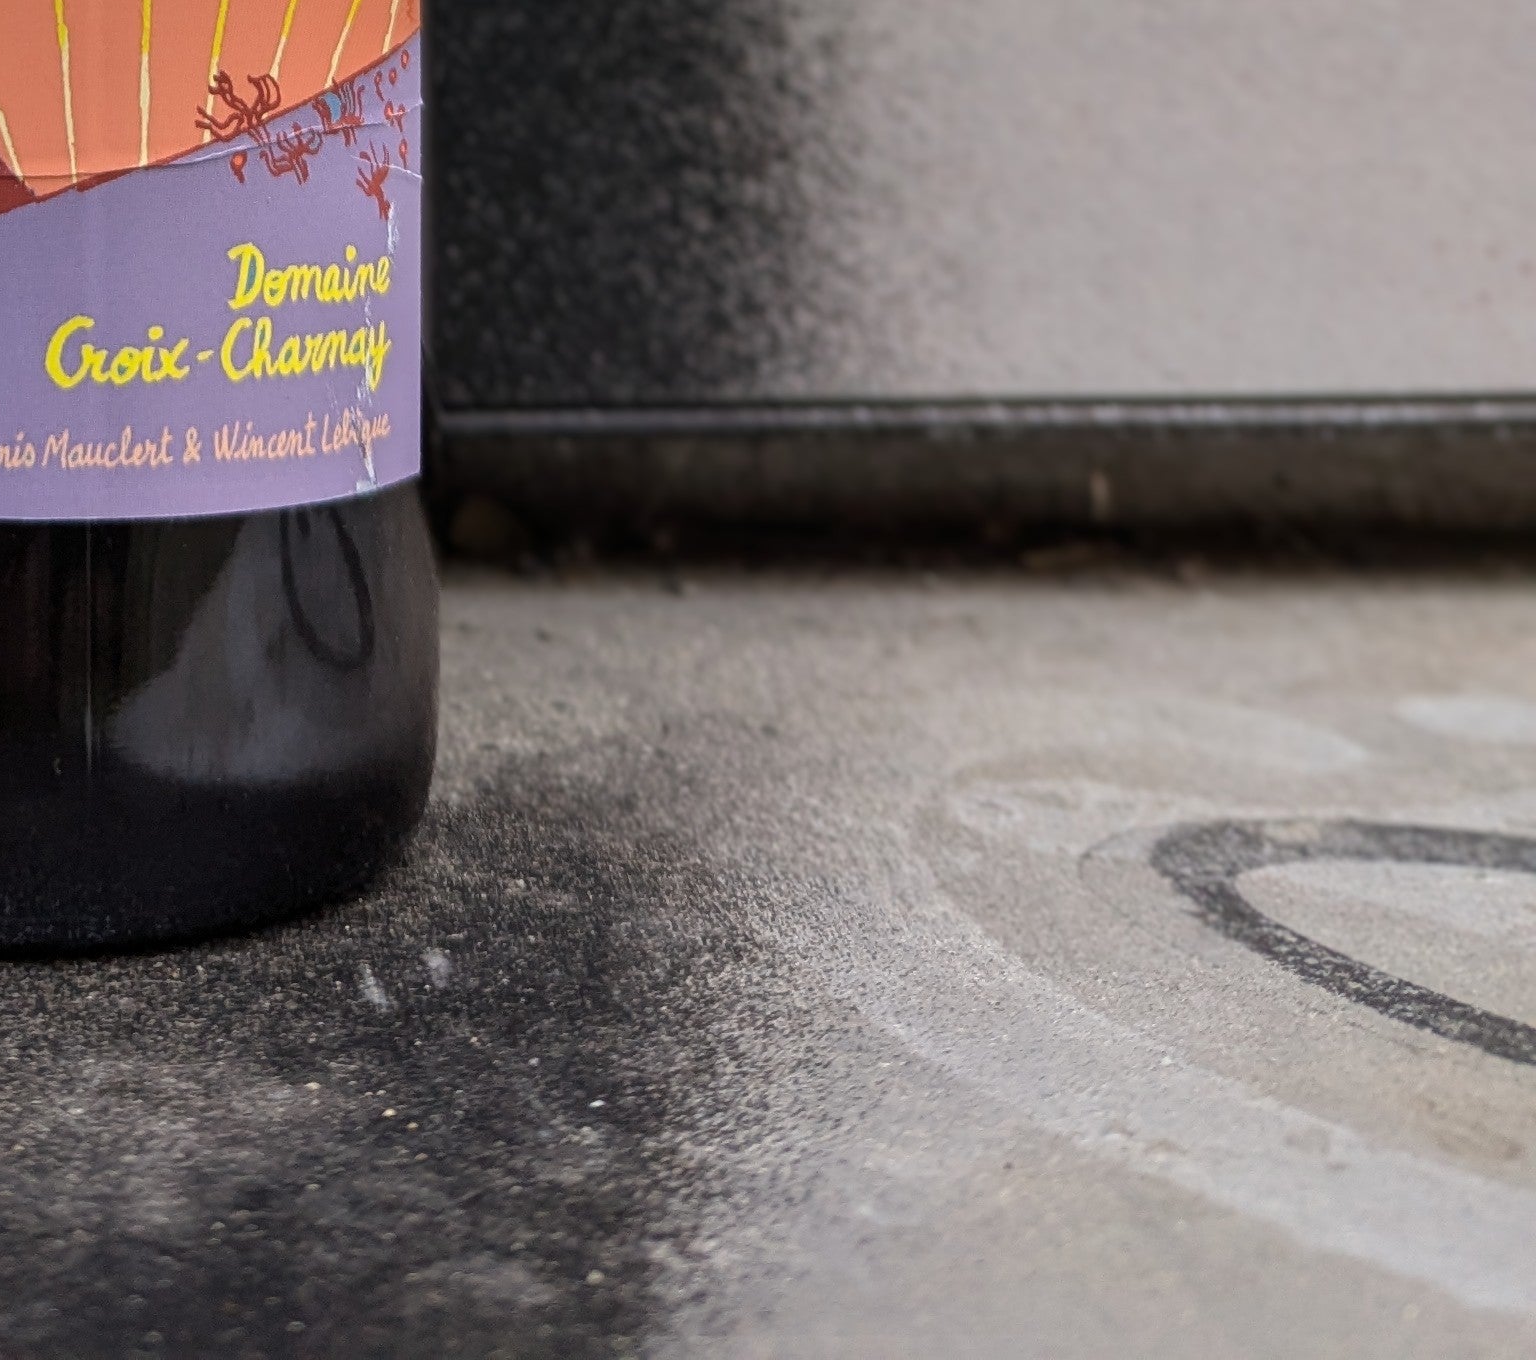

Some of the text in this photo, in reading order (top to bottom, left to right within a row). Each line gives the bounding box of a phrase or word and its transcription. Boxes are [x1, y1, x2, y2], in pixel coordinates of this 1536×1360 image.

[227, 241, 390, 311] Domaine
[44, 314, 391, 391] Croix-Charnay
[182, 425, 202, 464] &
